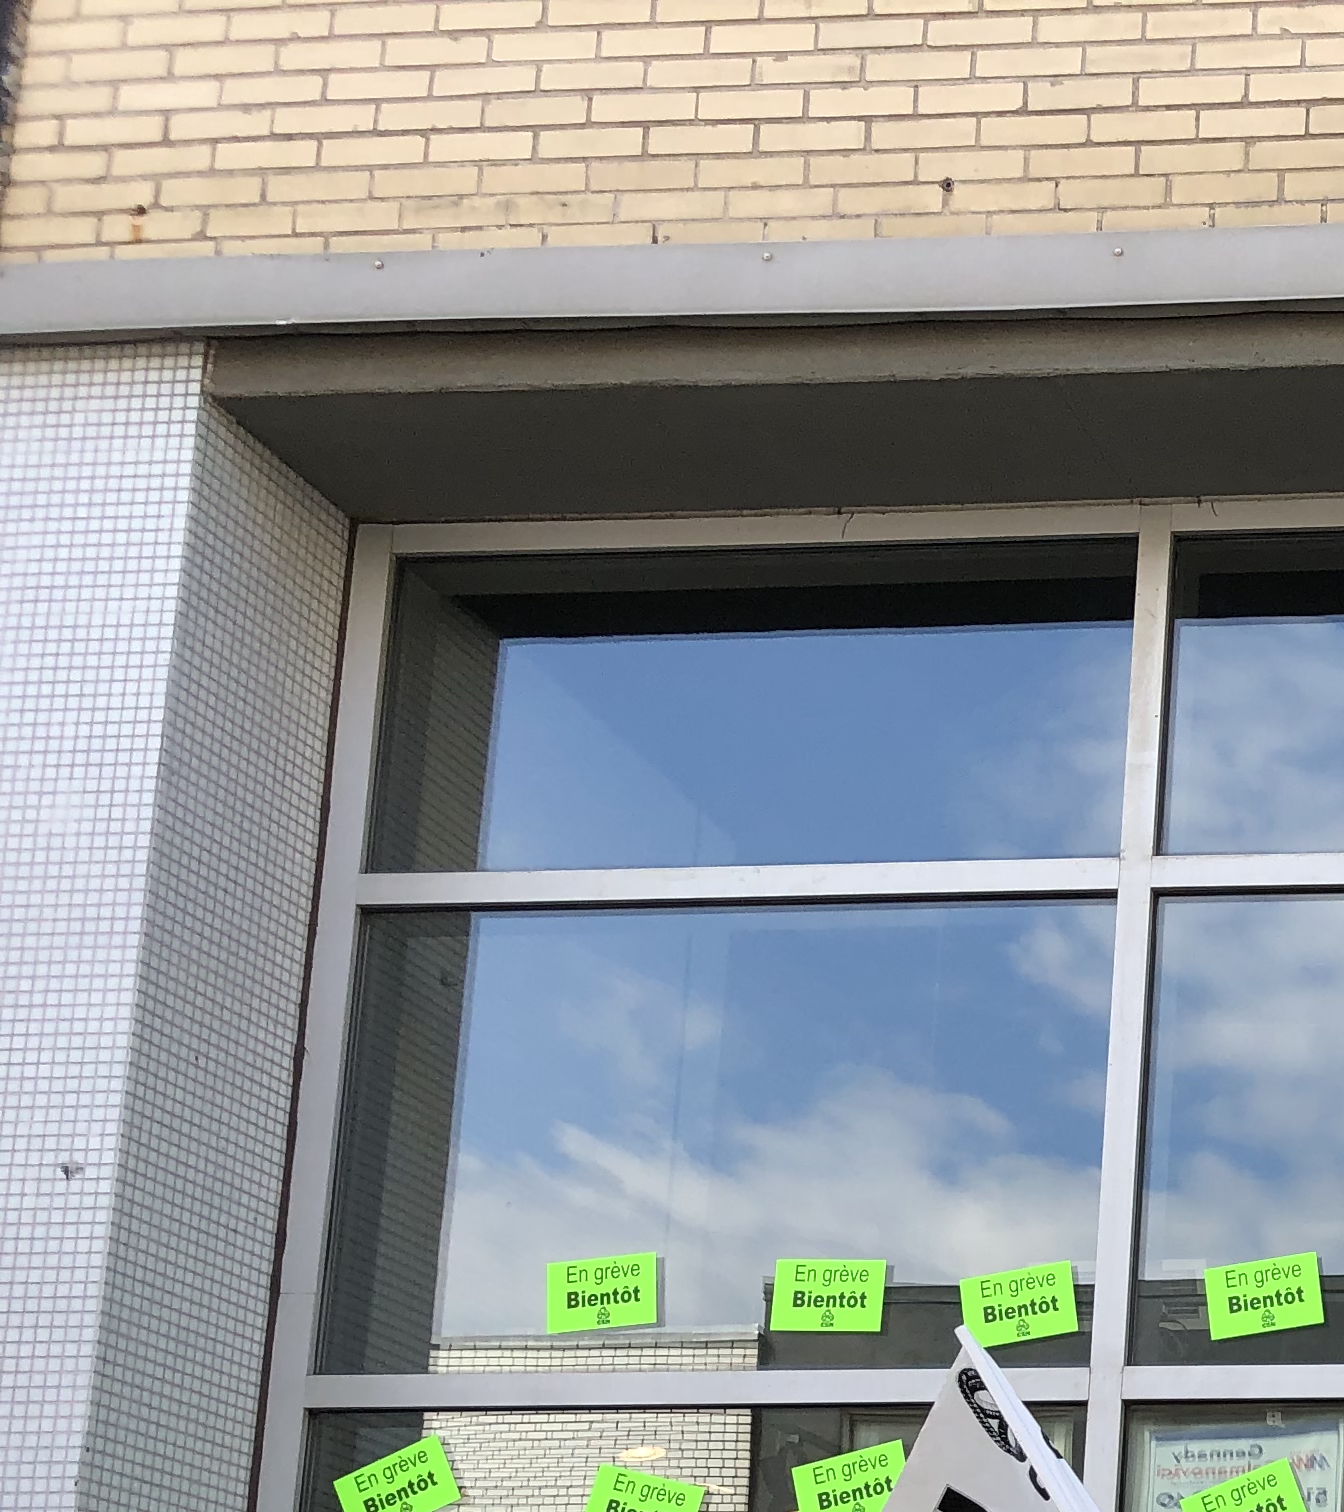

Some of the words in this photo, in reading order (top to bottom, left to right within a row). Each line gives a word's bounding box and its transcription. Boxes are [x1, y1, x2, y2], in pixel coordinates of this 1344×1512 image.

[566, 1265, 588, 1284] En
[594, 1261, 640, 1286] grève
[1225, 1269, 1248, 1289] En
[1254, 1262, 1302, 1289] grève
[566, 1285, 641, 1310] Bientôt
[1227, 1286, 1305, 1315] Bientôt
[353, 1473, 379, 1493] En
[382, 1450, 429, 1485] grève
